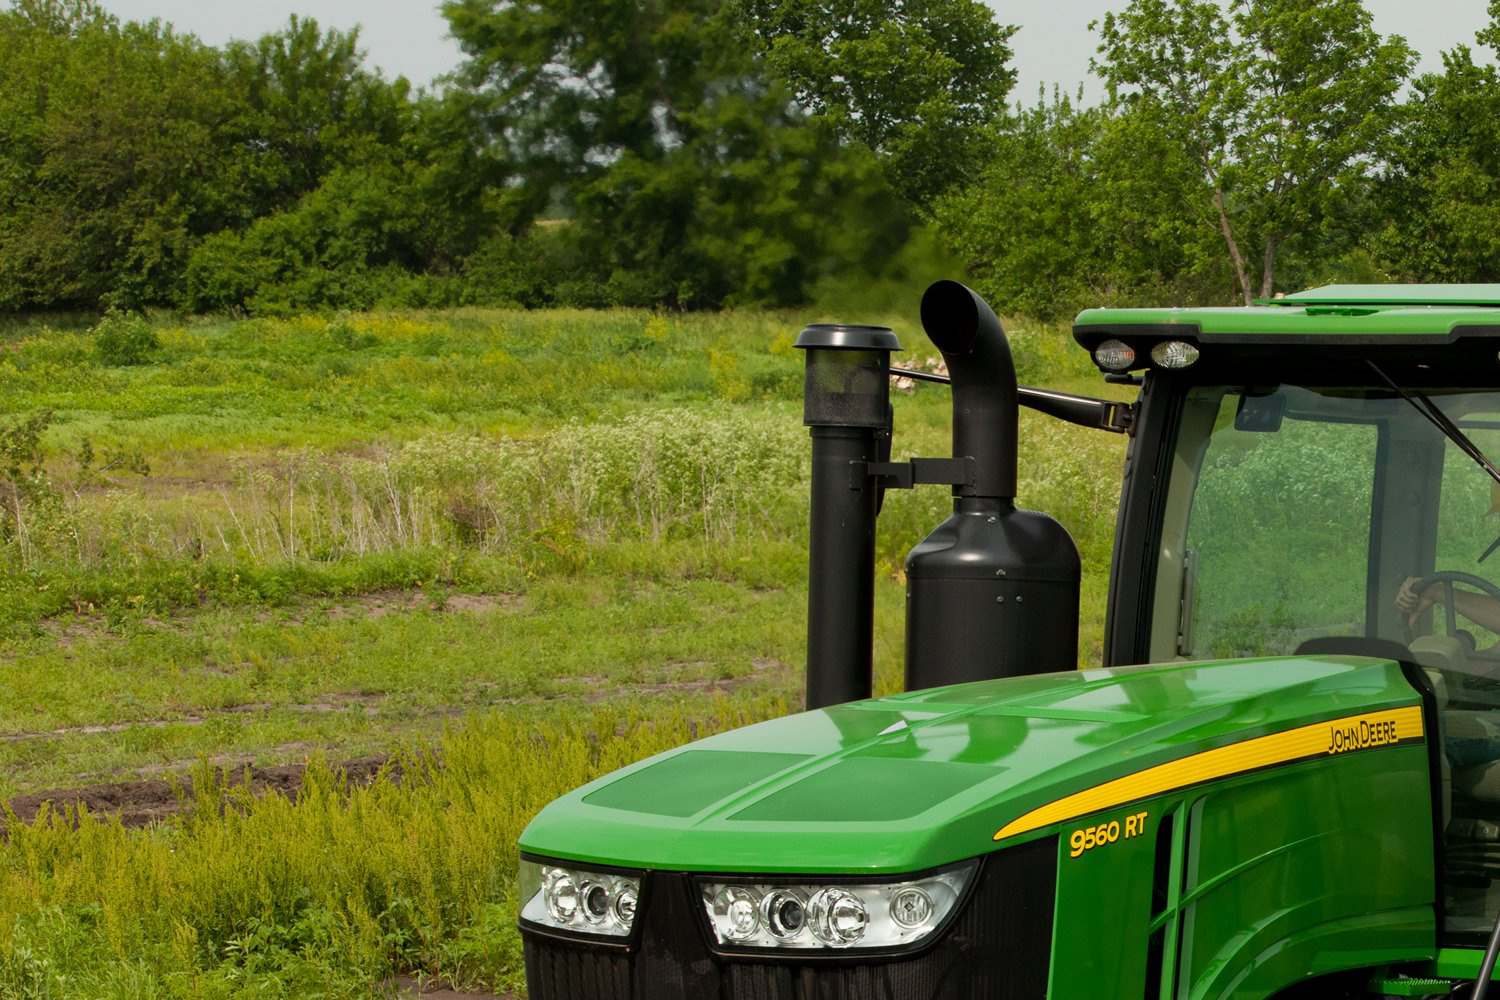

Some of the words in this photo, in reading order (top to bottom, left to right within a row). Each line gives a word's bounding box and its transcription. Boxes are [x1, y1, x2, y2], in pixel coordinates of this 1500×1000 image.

[1328, 727, 1359, 750] JOHN
[1360, 720, 1397, 744] DEERE
[1070, 821, 1120, 858] 9560
[1125, 812, 1148, 838] RT
